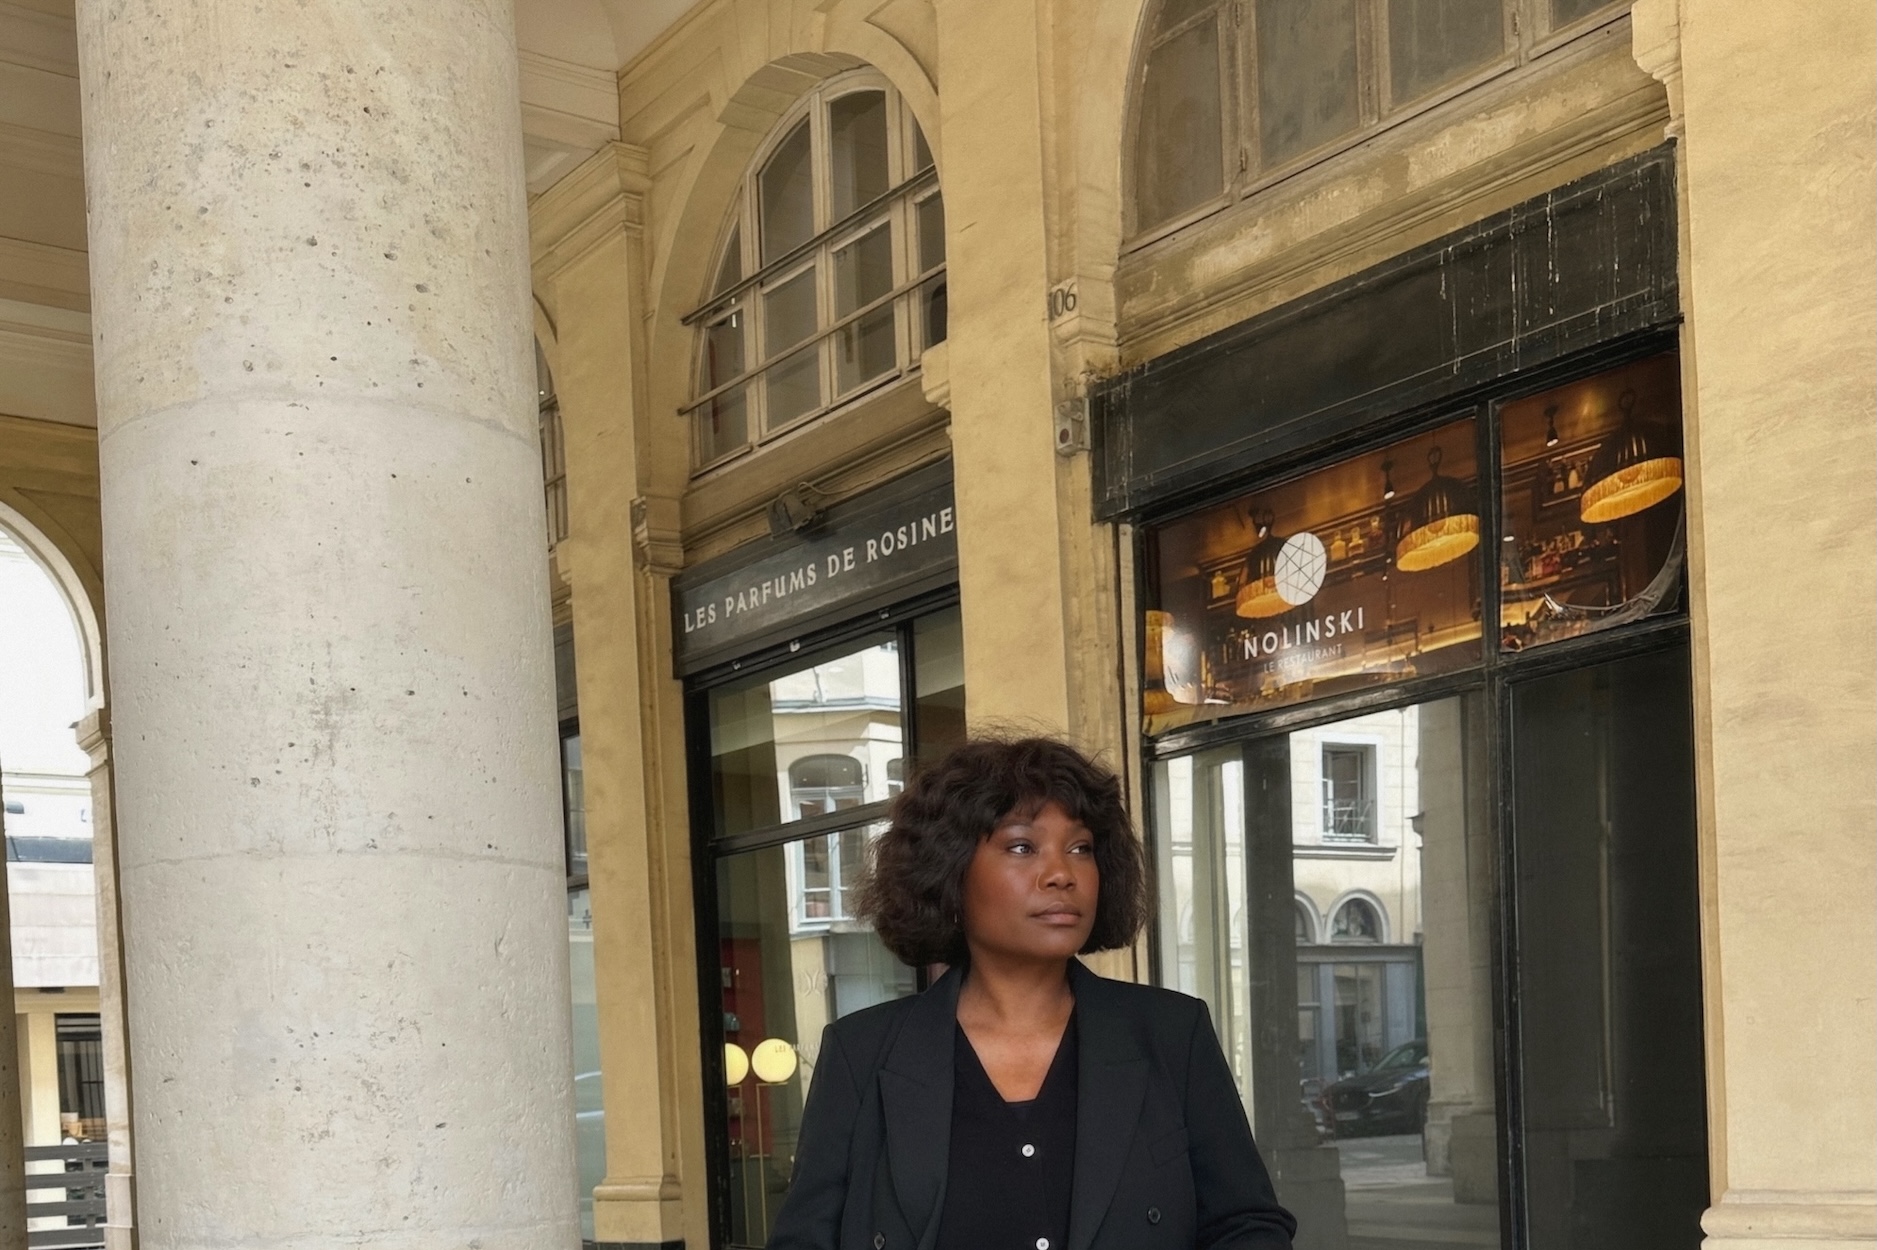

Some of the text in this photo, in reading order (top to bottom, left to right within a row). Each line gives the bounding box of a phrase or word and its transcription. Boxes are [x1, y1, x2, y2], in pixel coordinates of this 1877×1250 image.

[684, 507, 955, 633] LES PARFUMS DE ROSINE
[1244, 607, 1363, 659] NOLINSKI
[1263, 643, 1342, 674] LE RESTAURANT
